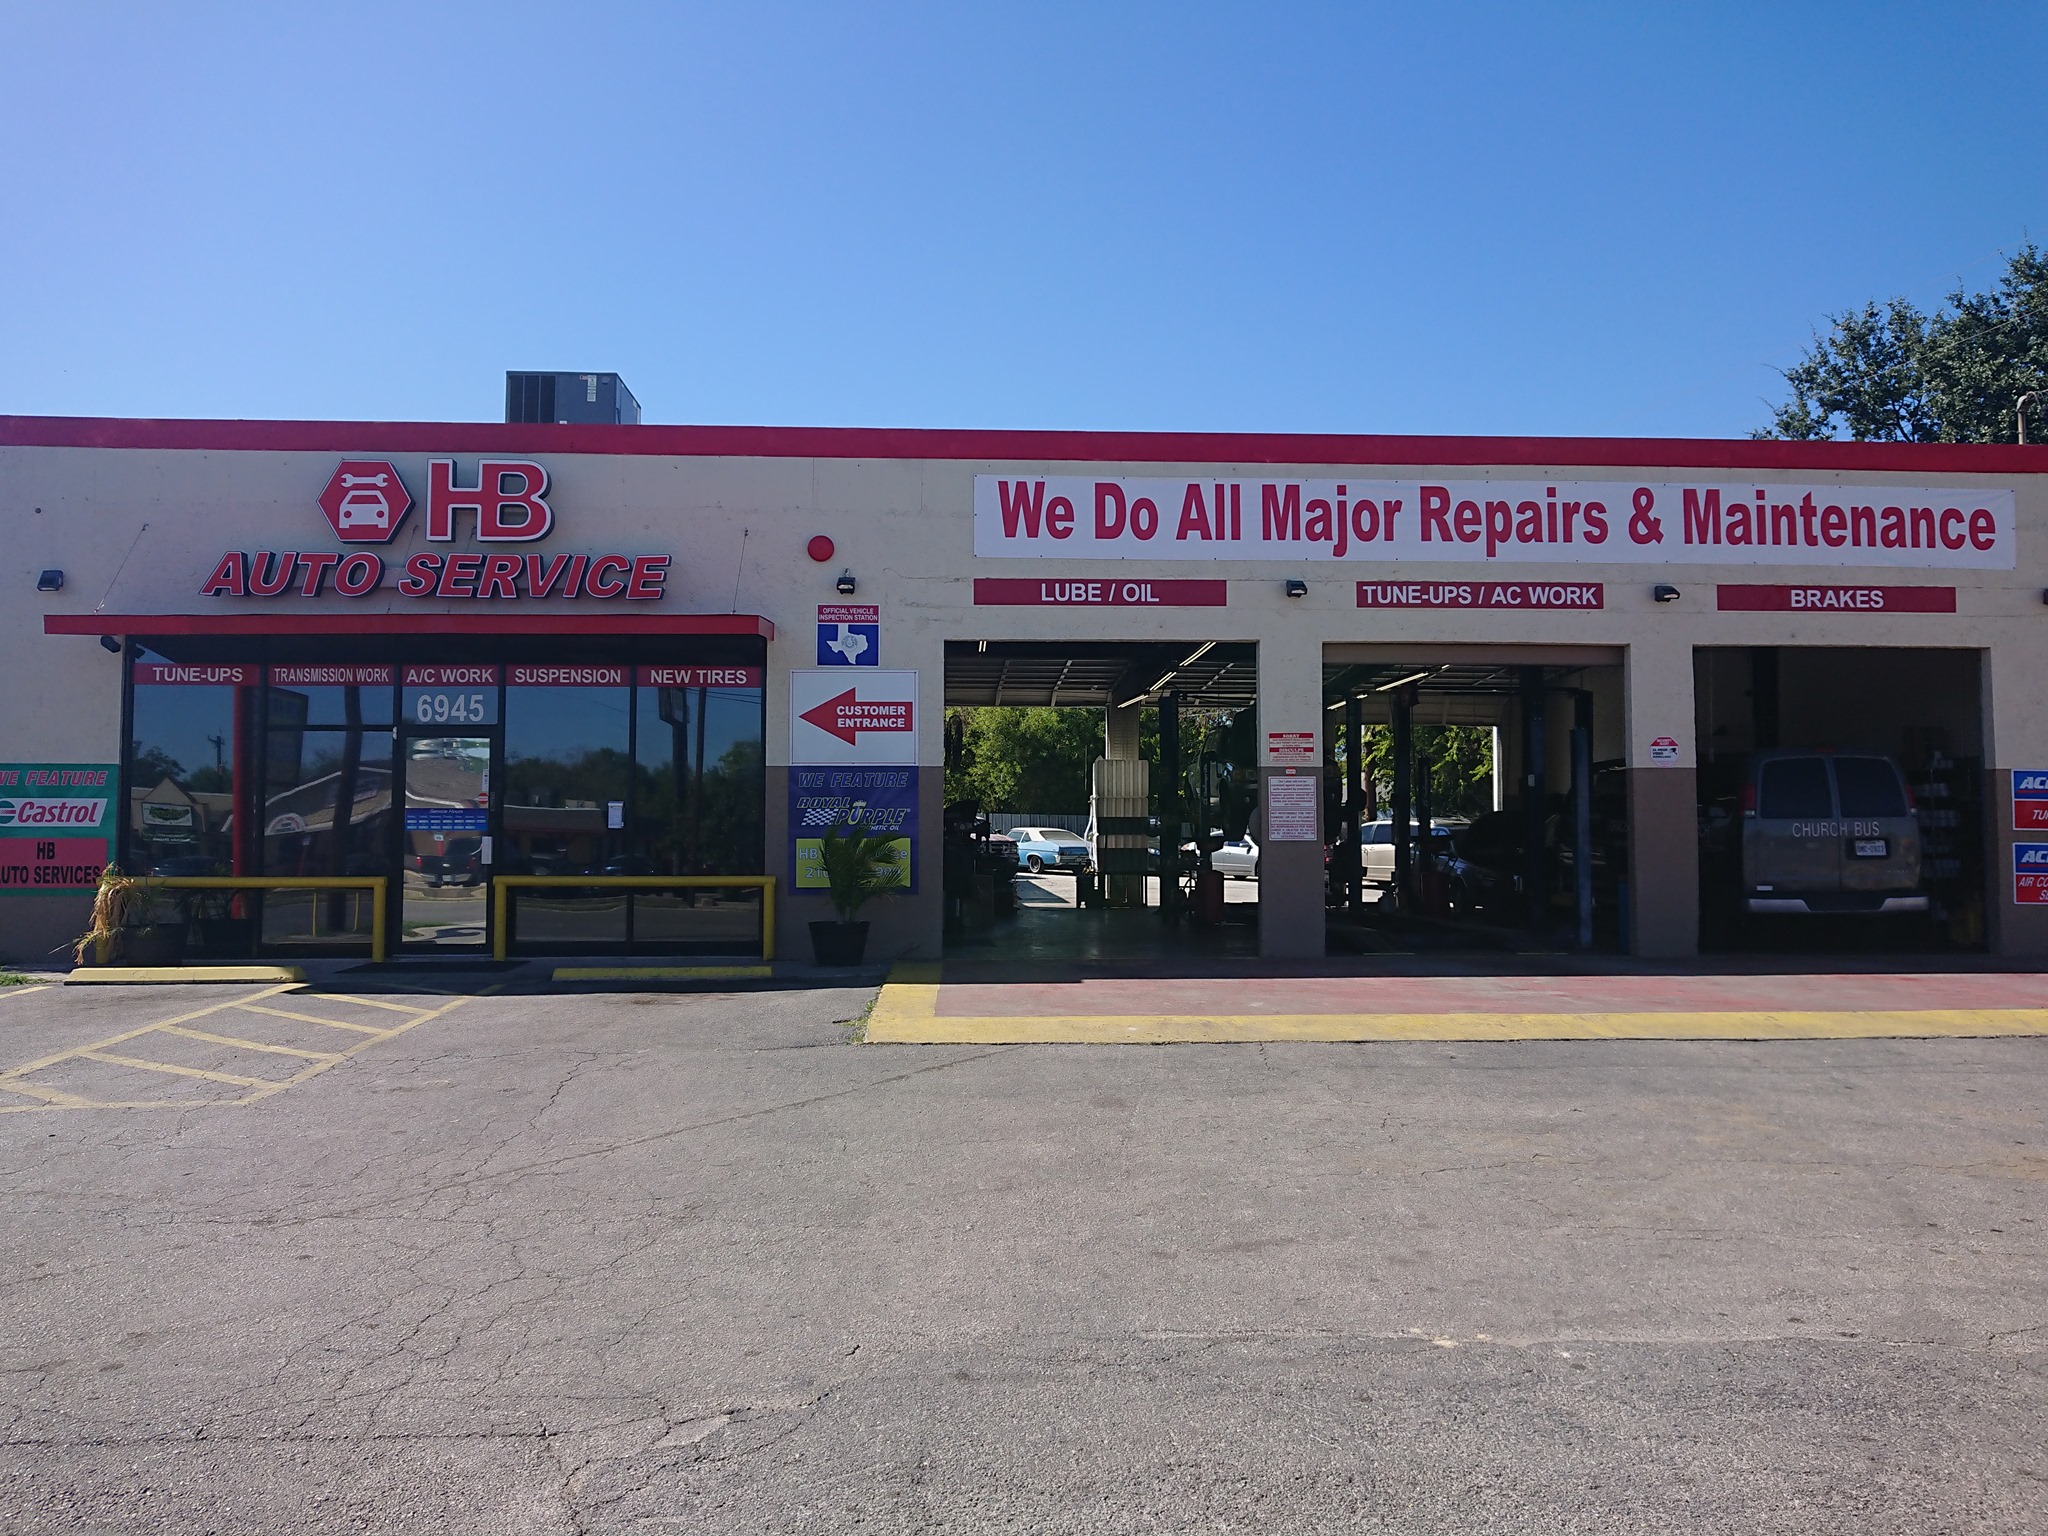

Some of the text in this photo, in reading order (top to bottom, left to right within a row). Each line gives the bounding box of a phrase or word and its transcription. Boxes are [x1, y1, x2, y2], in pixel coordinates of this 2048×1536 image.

[425, 458, 553, 542] HB
[997, 480, 1997, 558] We Do All Major Repairs & Maintenance
[199, 551, 671, 600] AUTO SERVICE
[1041, 583, 1160, 602] LUBE / OIL
[1363, 585, 1598, 606] TUNE-UPS / AC WORK
[1790, 589, 1885, 609] BRAKES
[152, 667, 244, 682] TUNE-UPS
[274, 668, 390, 683] TRANSMISSION WORK
[406, 668, 494, 683] A/C WORK
[514, 669, 622, 684] SUSPENSION
[650, 670, 748, 685] NEW TIRES
[416, 694, 485, 722] 6945
[836, 705, 907, 716] CUSTOMER
[837, 717, 906, 728] ENTRANCE
[25, 771, 108, 786] FEATURE
[798, 772, 909, 788] WE FEATURE
[797, 796, 851, 808] ROYAL
[17, 801, 98, 823] Castrol
[1792, 821, 1881, 838] CHURCH BUS
[36, 842, 56, 860] HB
[799, 847, 819, 860] HB
[2018, 876, 2035, 888] AIR
